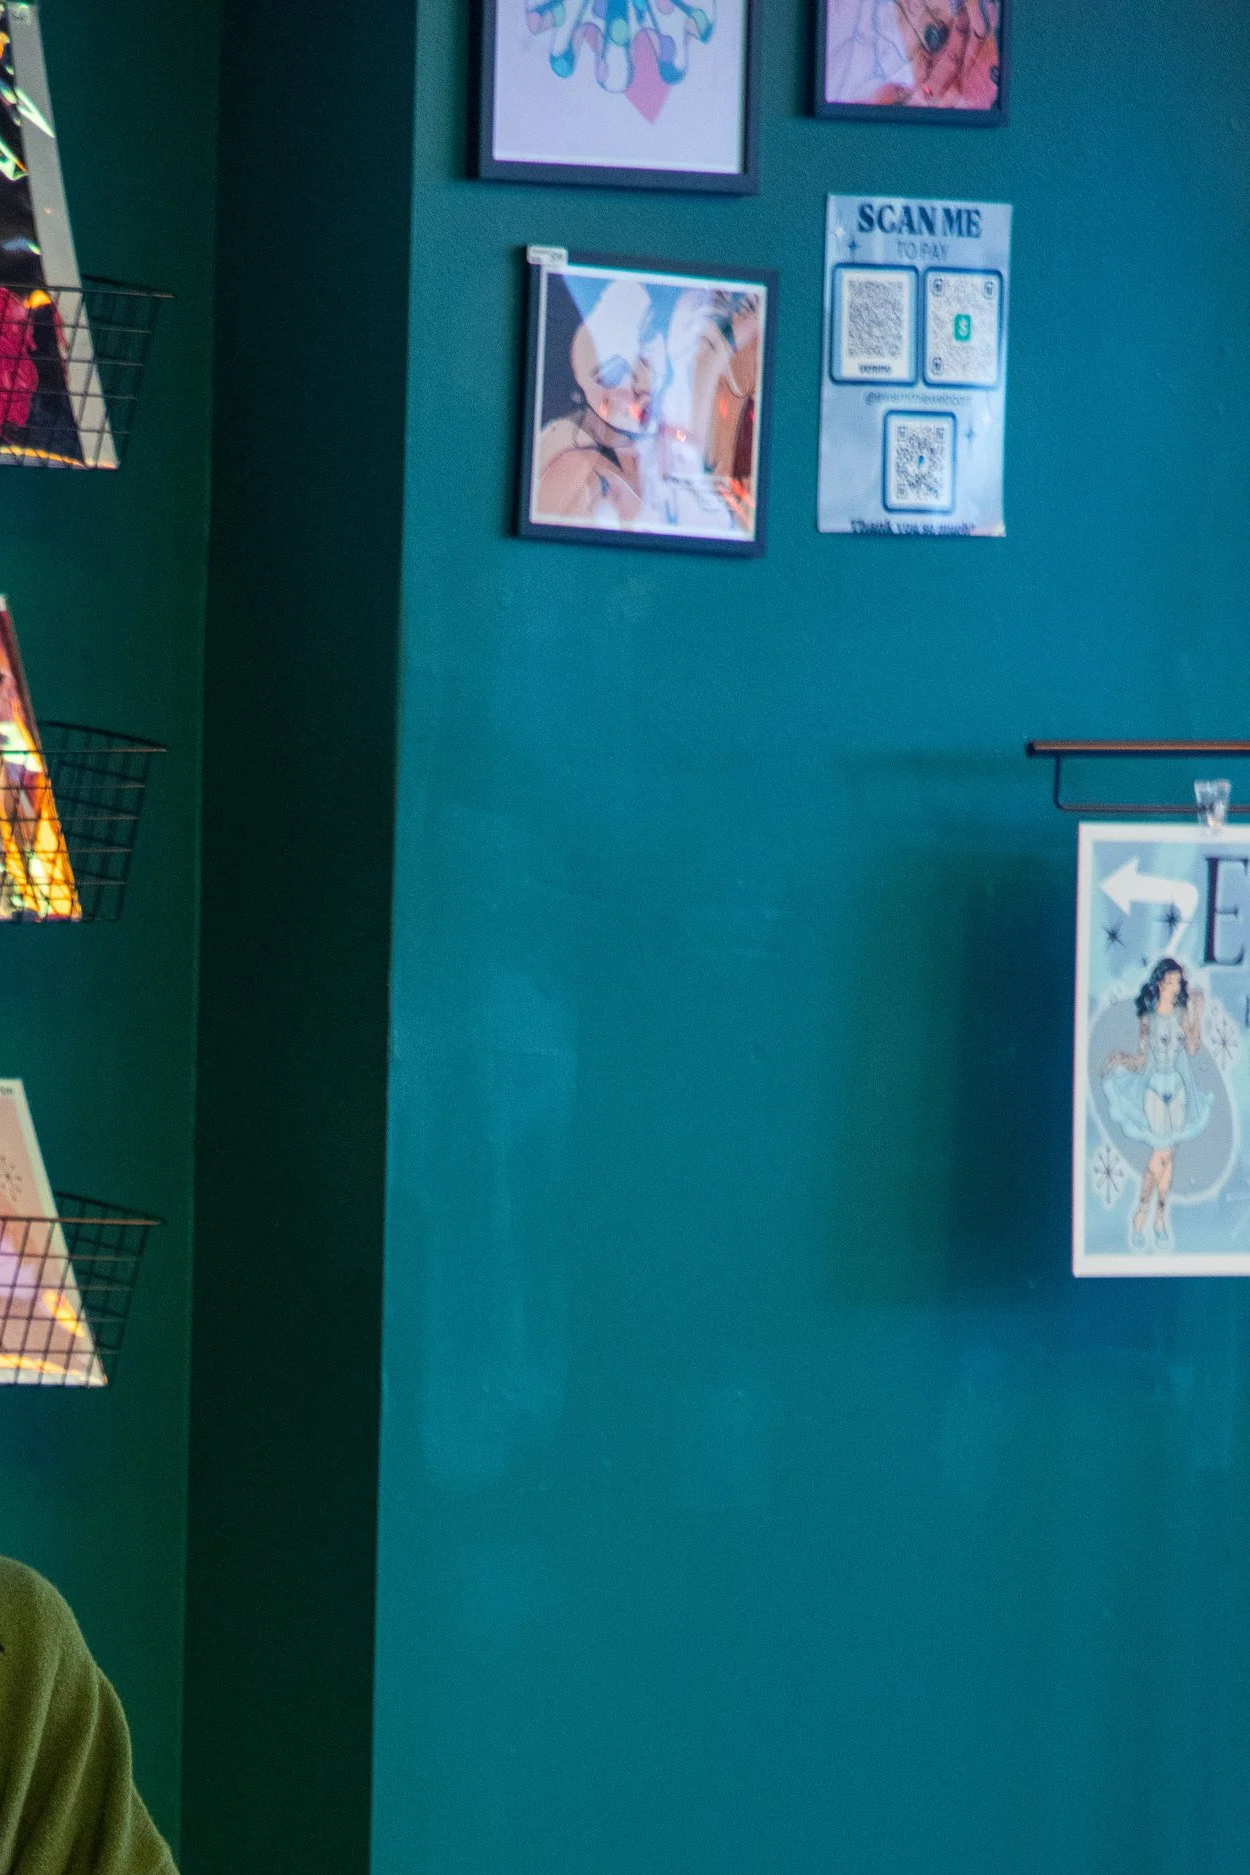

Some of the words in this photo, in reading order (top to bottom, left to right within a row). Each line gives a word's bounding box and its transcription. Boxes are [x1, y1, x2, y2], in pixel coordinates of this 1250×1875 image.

[857, 203, 936, 236] SCAN
[941, 206, 982, 238] ME
[897, 241, 917, 260] TO
[920, 242, 947, 261] PAY
